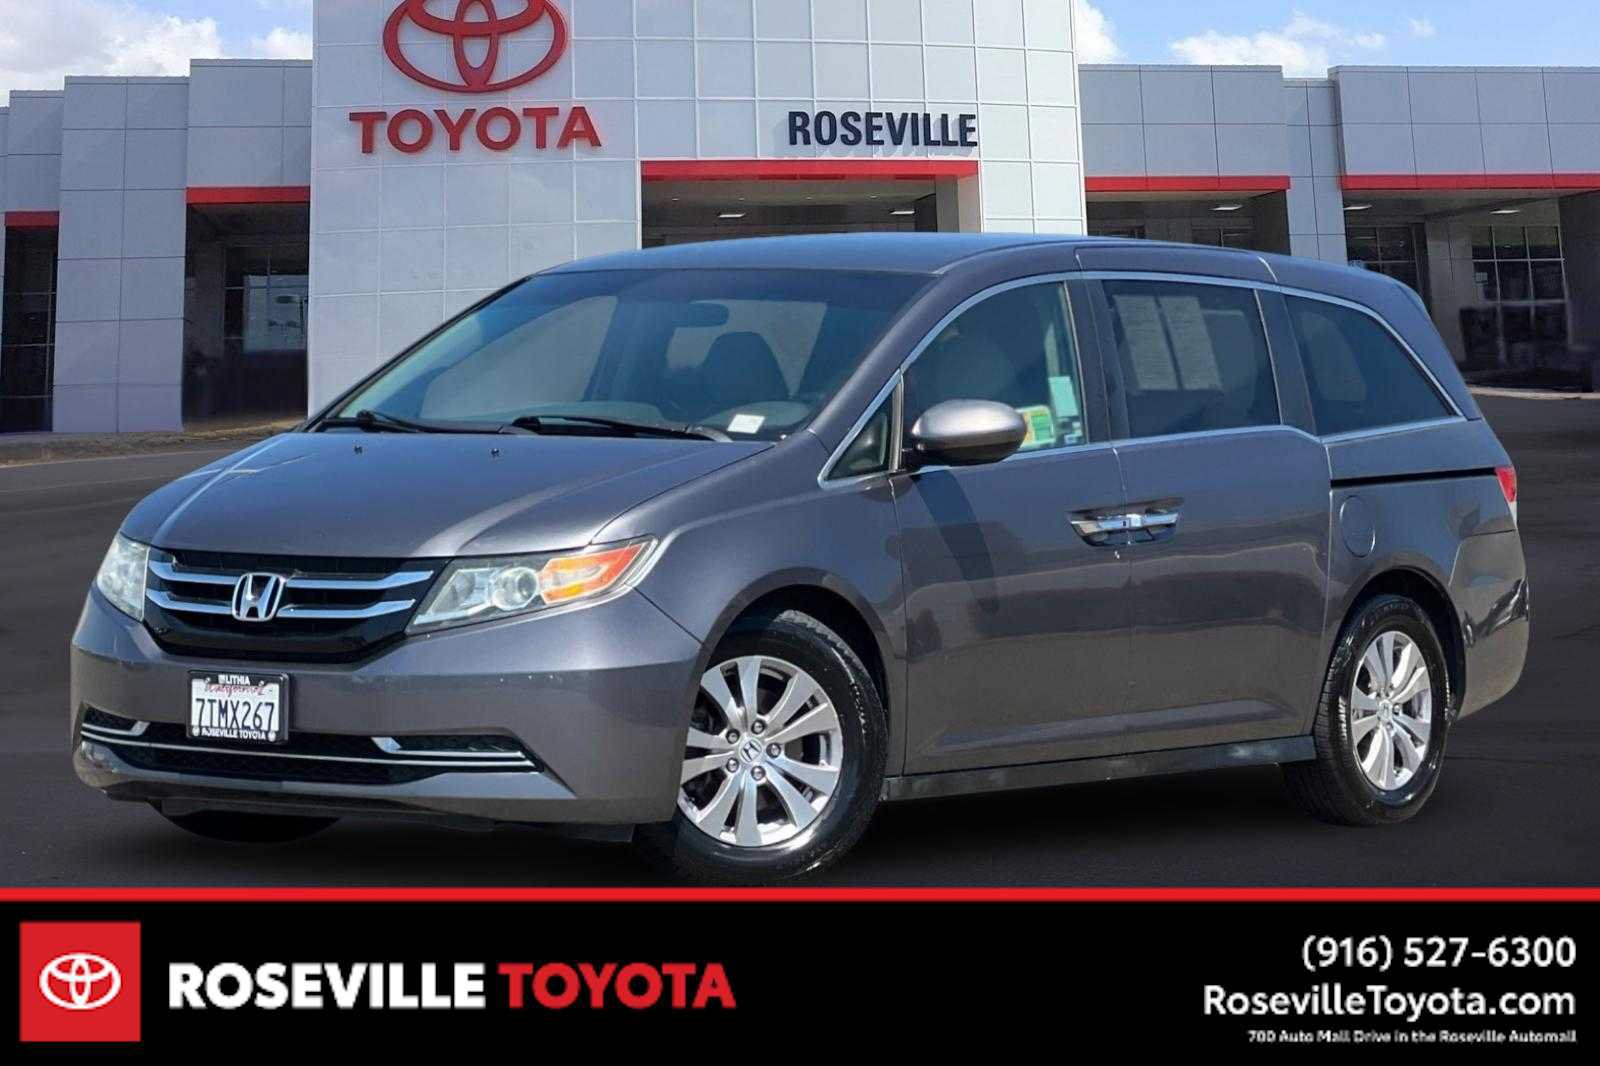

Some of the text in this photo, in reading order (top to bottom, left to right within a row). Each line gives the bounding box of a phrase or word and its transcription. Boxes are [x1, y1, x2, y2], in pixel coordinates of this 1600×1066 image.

[349, 106, 602, 154] TOYOTA
[788, 110, 978, 147] ROSEVILLE
[225, 674, 251, 685] LITHIA
[194, 697, 275, 732] 7TMX267
[239, 729, 267, 741] TOYOTA
